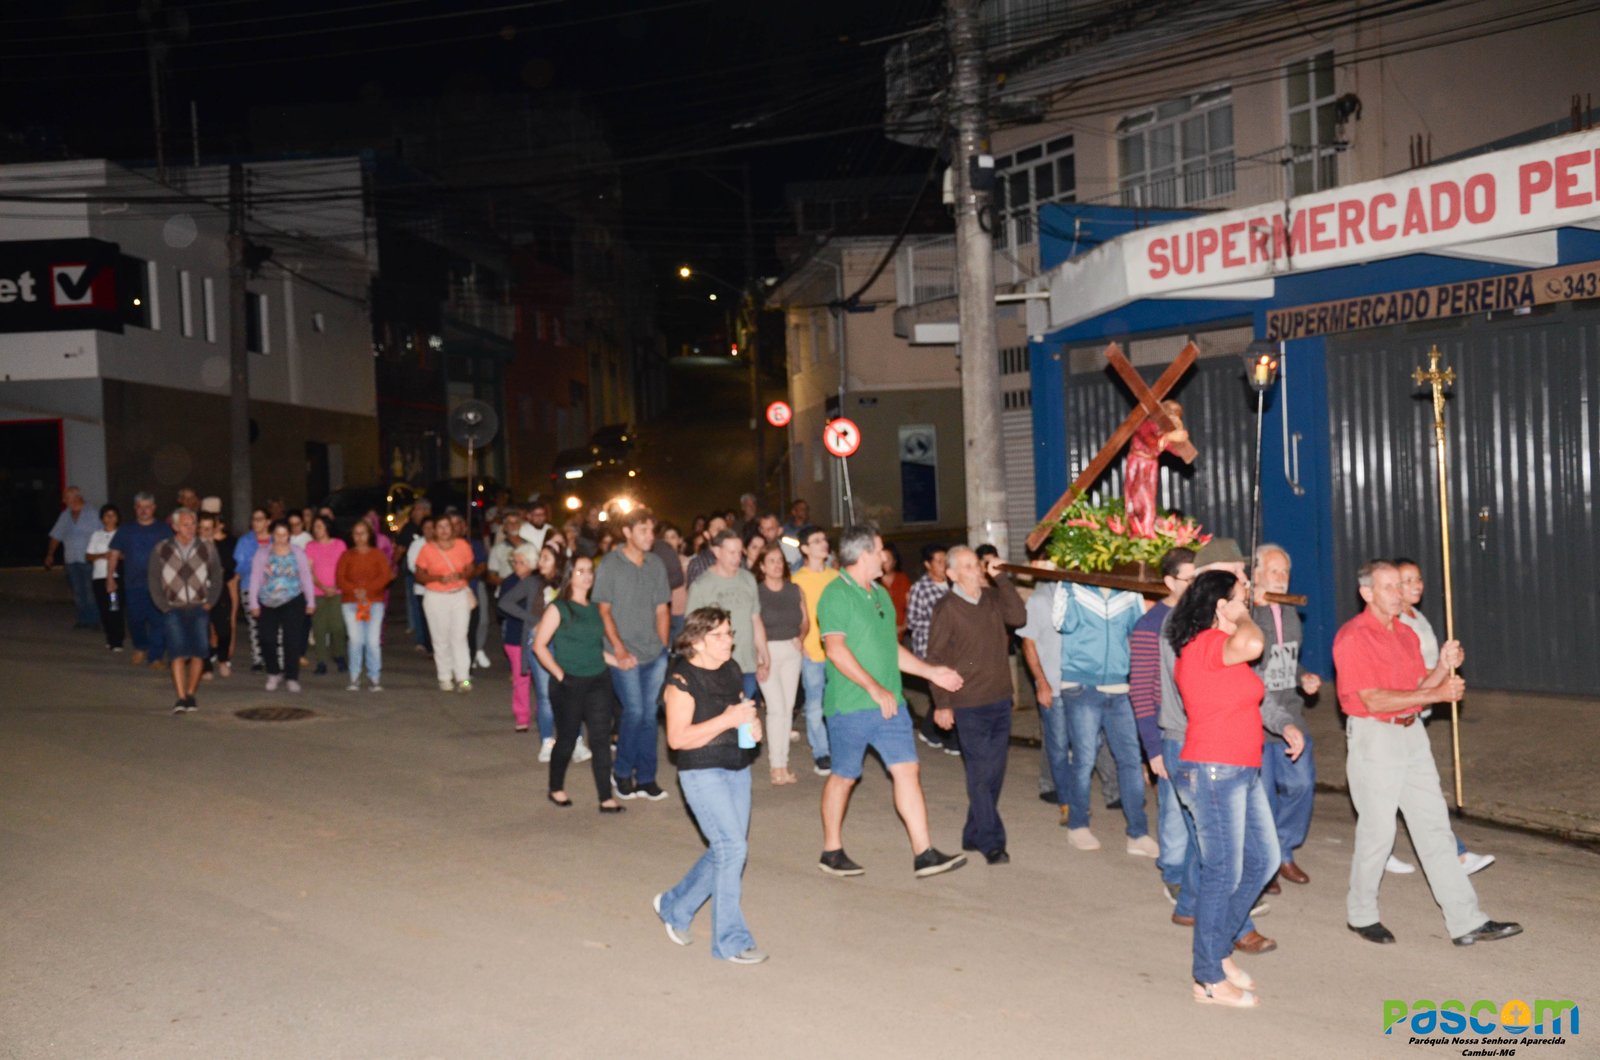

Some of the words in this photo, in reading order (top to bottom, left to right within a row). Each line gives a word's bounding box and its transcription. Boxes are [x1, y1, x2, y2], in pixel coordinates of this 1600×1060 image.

[1147, 172, 1496, 280] SUPERMERCADO
[1268, 289, 1430, 343] SUPERMERCADO
[1437, 275, 1536, 316] PEREIRA
[1563, 272, 1600, 298] 343
